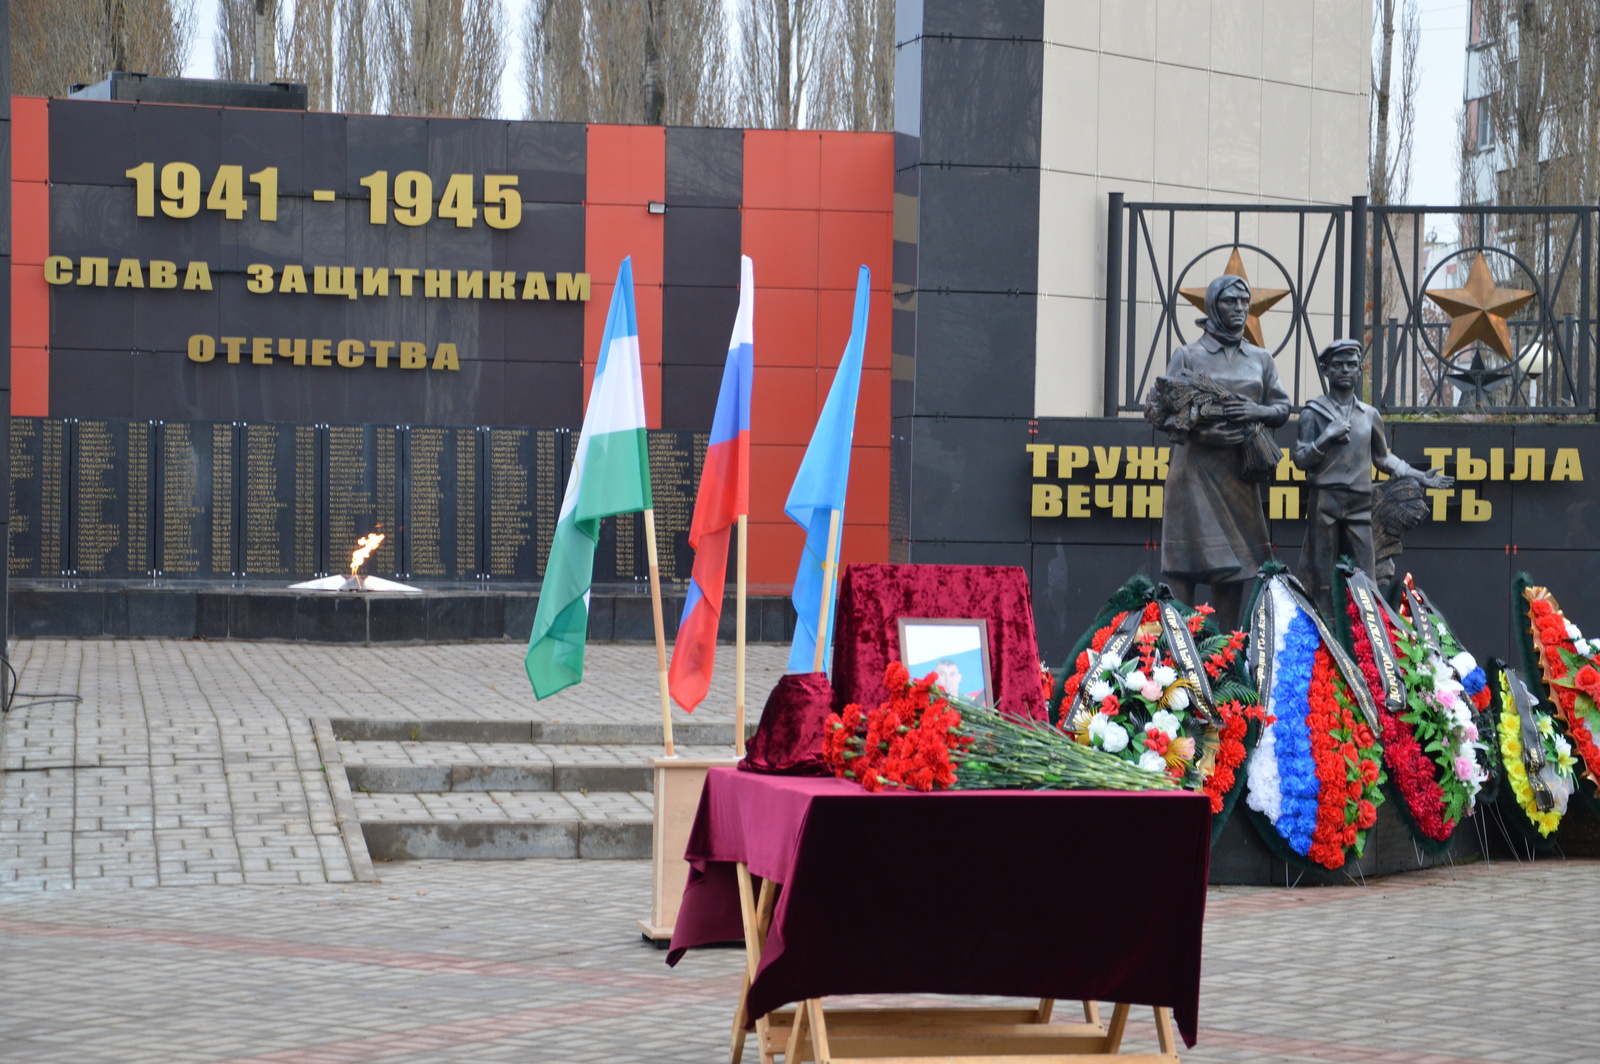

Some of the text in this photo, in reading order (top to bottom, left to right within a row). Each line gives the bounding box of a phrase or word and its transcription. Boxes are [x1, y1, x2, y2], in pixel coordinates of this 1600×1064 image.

[126, 162, 278, 221] 1941
[360, 170, 522, 229] 1945
[44, 256, 591, 301] СЛАВА ЗАЩИТНИКАМ
[187, 334, 460, 370] ОТЕЧЕСТВА
[1424, 447, 1584, 481] ТЫЛА
[1031, 484, 1164, 519] ВЕЧН
